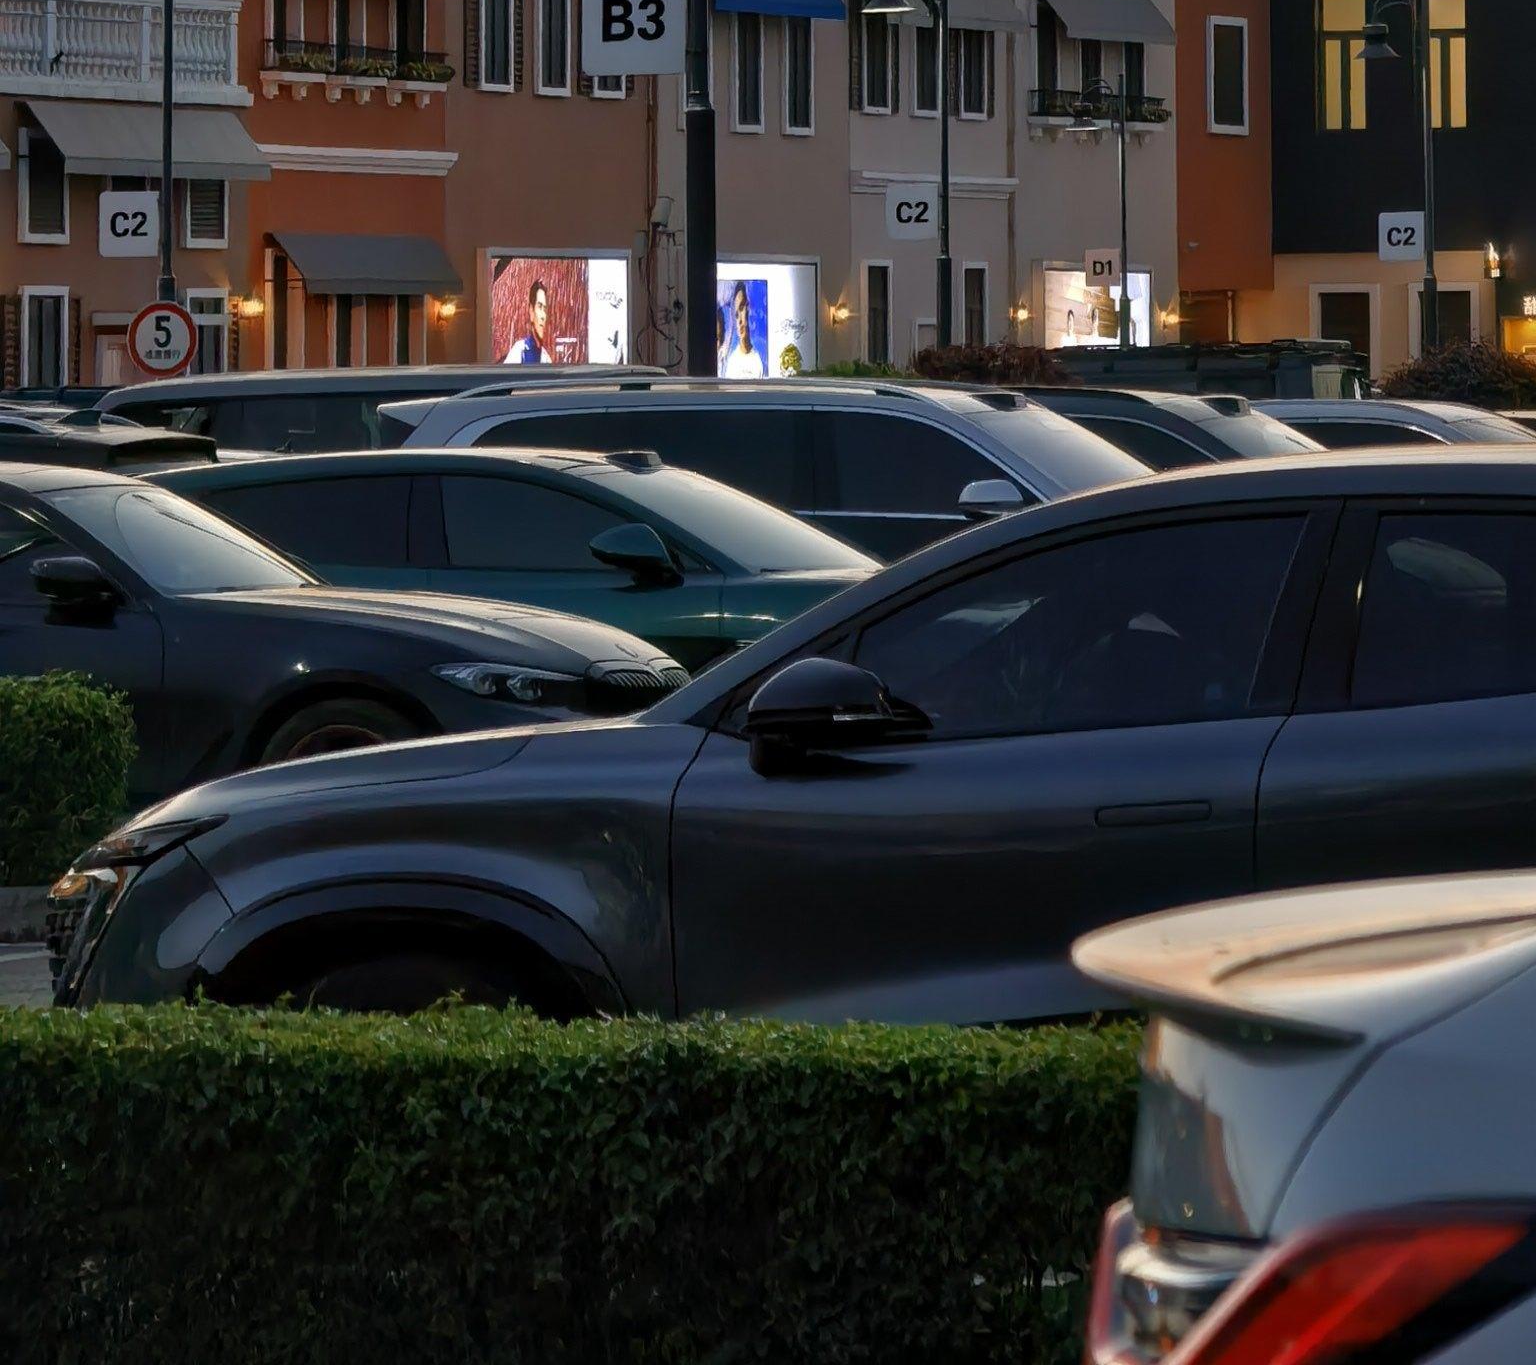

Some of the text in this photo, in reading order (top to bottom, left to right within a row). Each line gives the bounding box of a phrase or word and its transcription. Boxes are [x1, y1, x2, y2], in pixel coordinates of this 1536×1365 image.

[895, 201, 930, 224] C2
[110, 212, 148, 238] C2
[1386, 226, 1416, 247] C2
[1093, 260, 1112, 276] D1
[153, 315, 172, 348] 5
